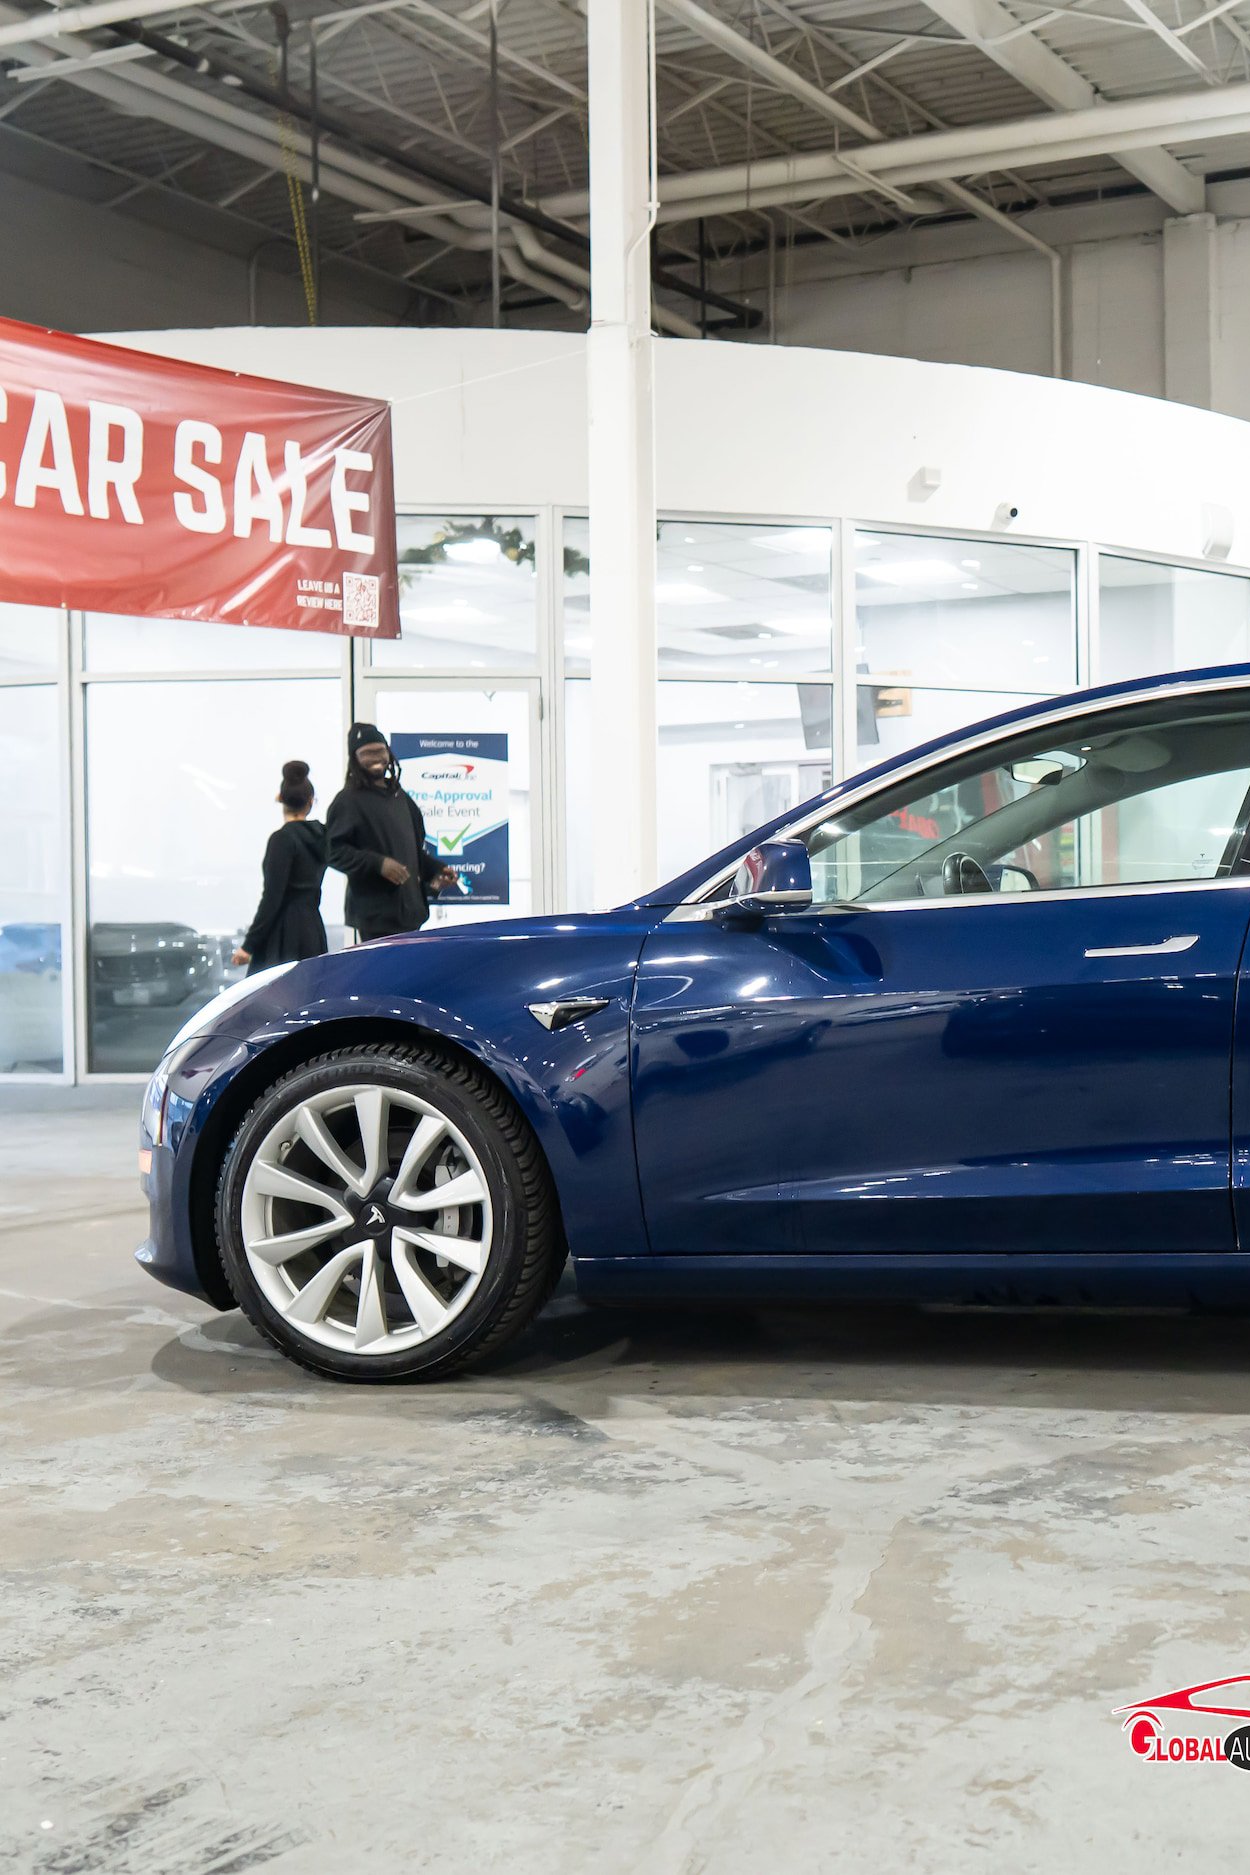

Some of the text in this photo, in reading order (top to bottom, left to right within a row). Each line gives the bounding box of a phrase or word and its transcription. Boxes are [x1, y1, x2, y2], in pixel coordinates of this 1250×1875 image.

[0, 384, 376, 555] AR SALE
[419, 739, 479, 748] Welcome to the
[447, 806, 480, 817] Event
